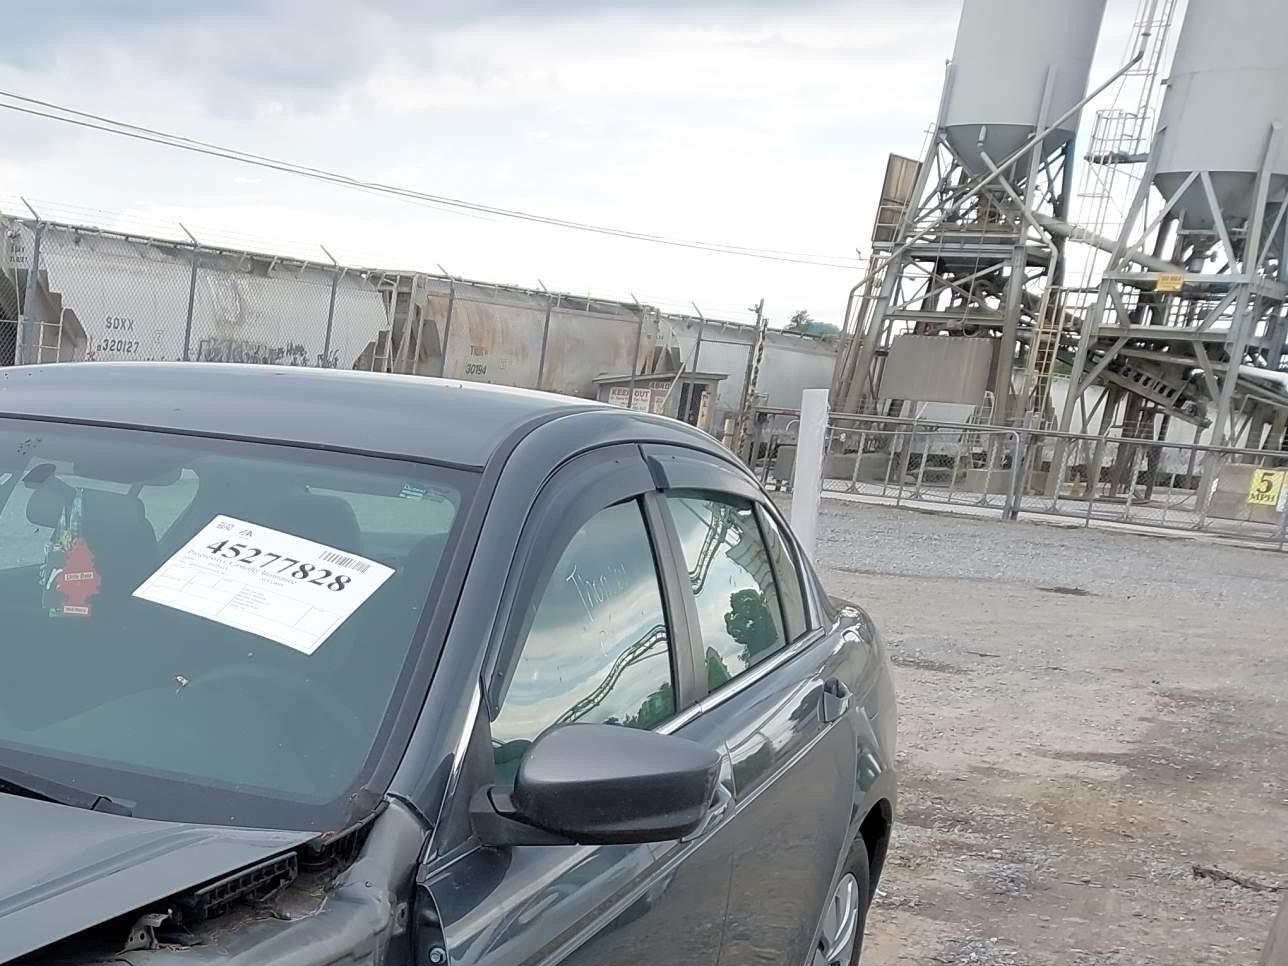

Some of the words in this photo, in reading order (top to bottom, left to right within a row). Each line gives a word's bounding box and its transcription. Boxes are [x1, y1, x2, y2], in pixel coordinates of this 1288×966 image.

[105, 316, 134, 331] SOXX
[103, 338, 140, 353] 320127
[634, 390, 650, 398] OUT
[1256, 472, 1275, 494] 5
[205, 539, 352, 592] 45277828
